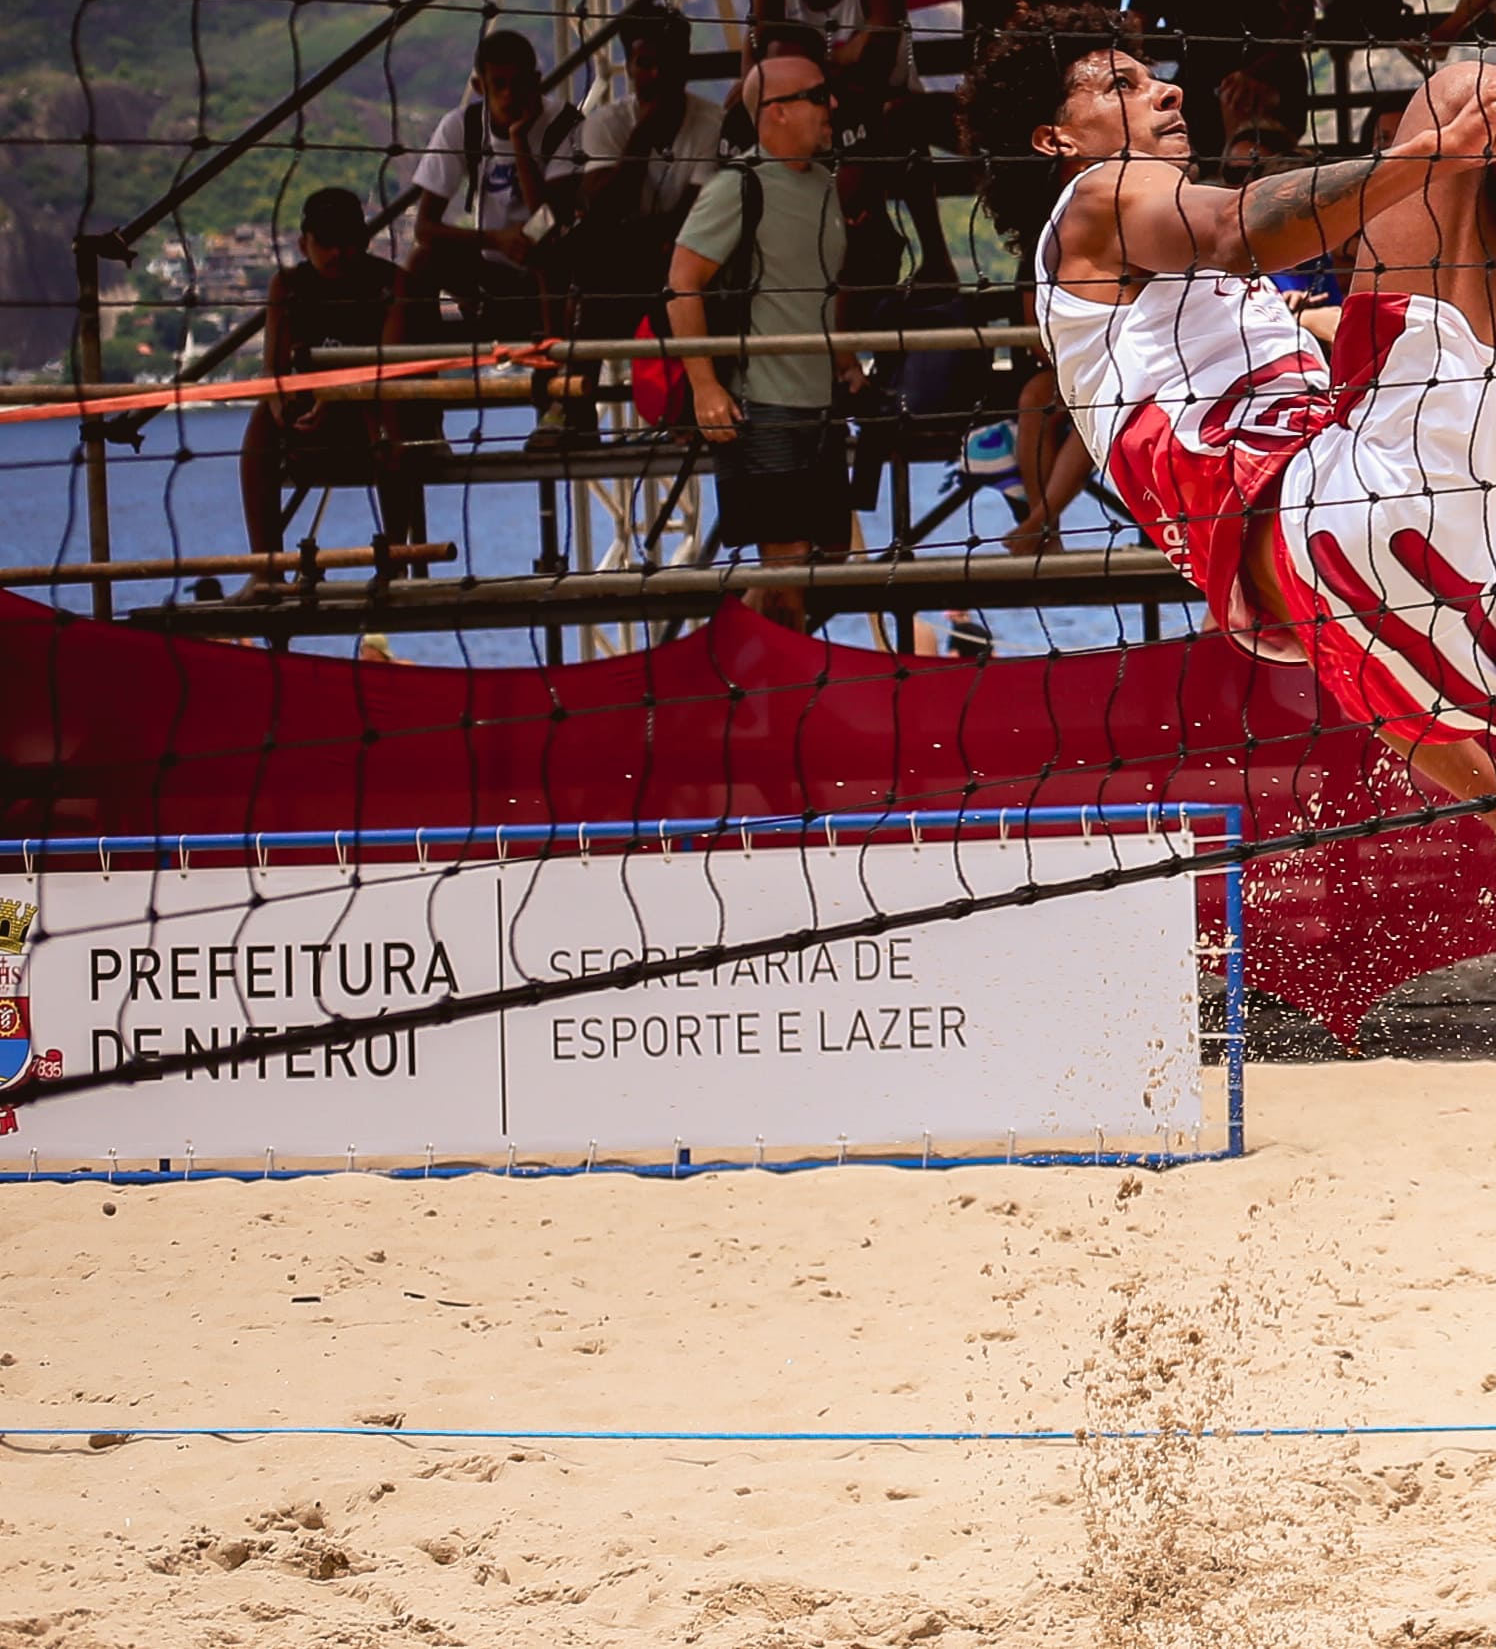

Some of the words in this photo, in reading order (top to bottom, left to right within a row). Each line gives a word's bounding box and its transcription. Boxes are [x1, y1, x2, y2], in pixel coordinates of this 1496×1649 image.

[88, 940, 460, 1002] PREFEITURA
[854, 936, 914, 982] DE
[91, 1027, 163, 1082] DE
[552, 1012, 761, 1061] ESPORTE
[777, 1011, 803, 1054] E
[818, 1005, 968, 1052] LAZER
